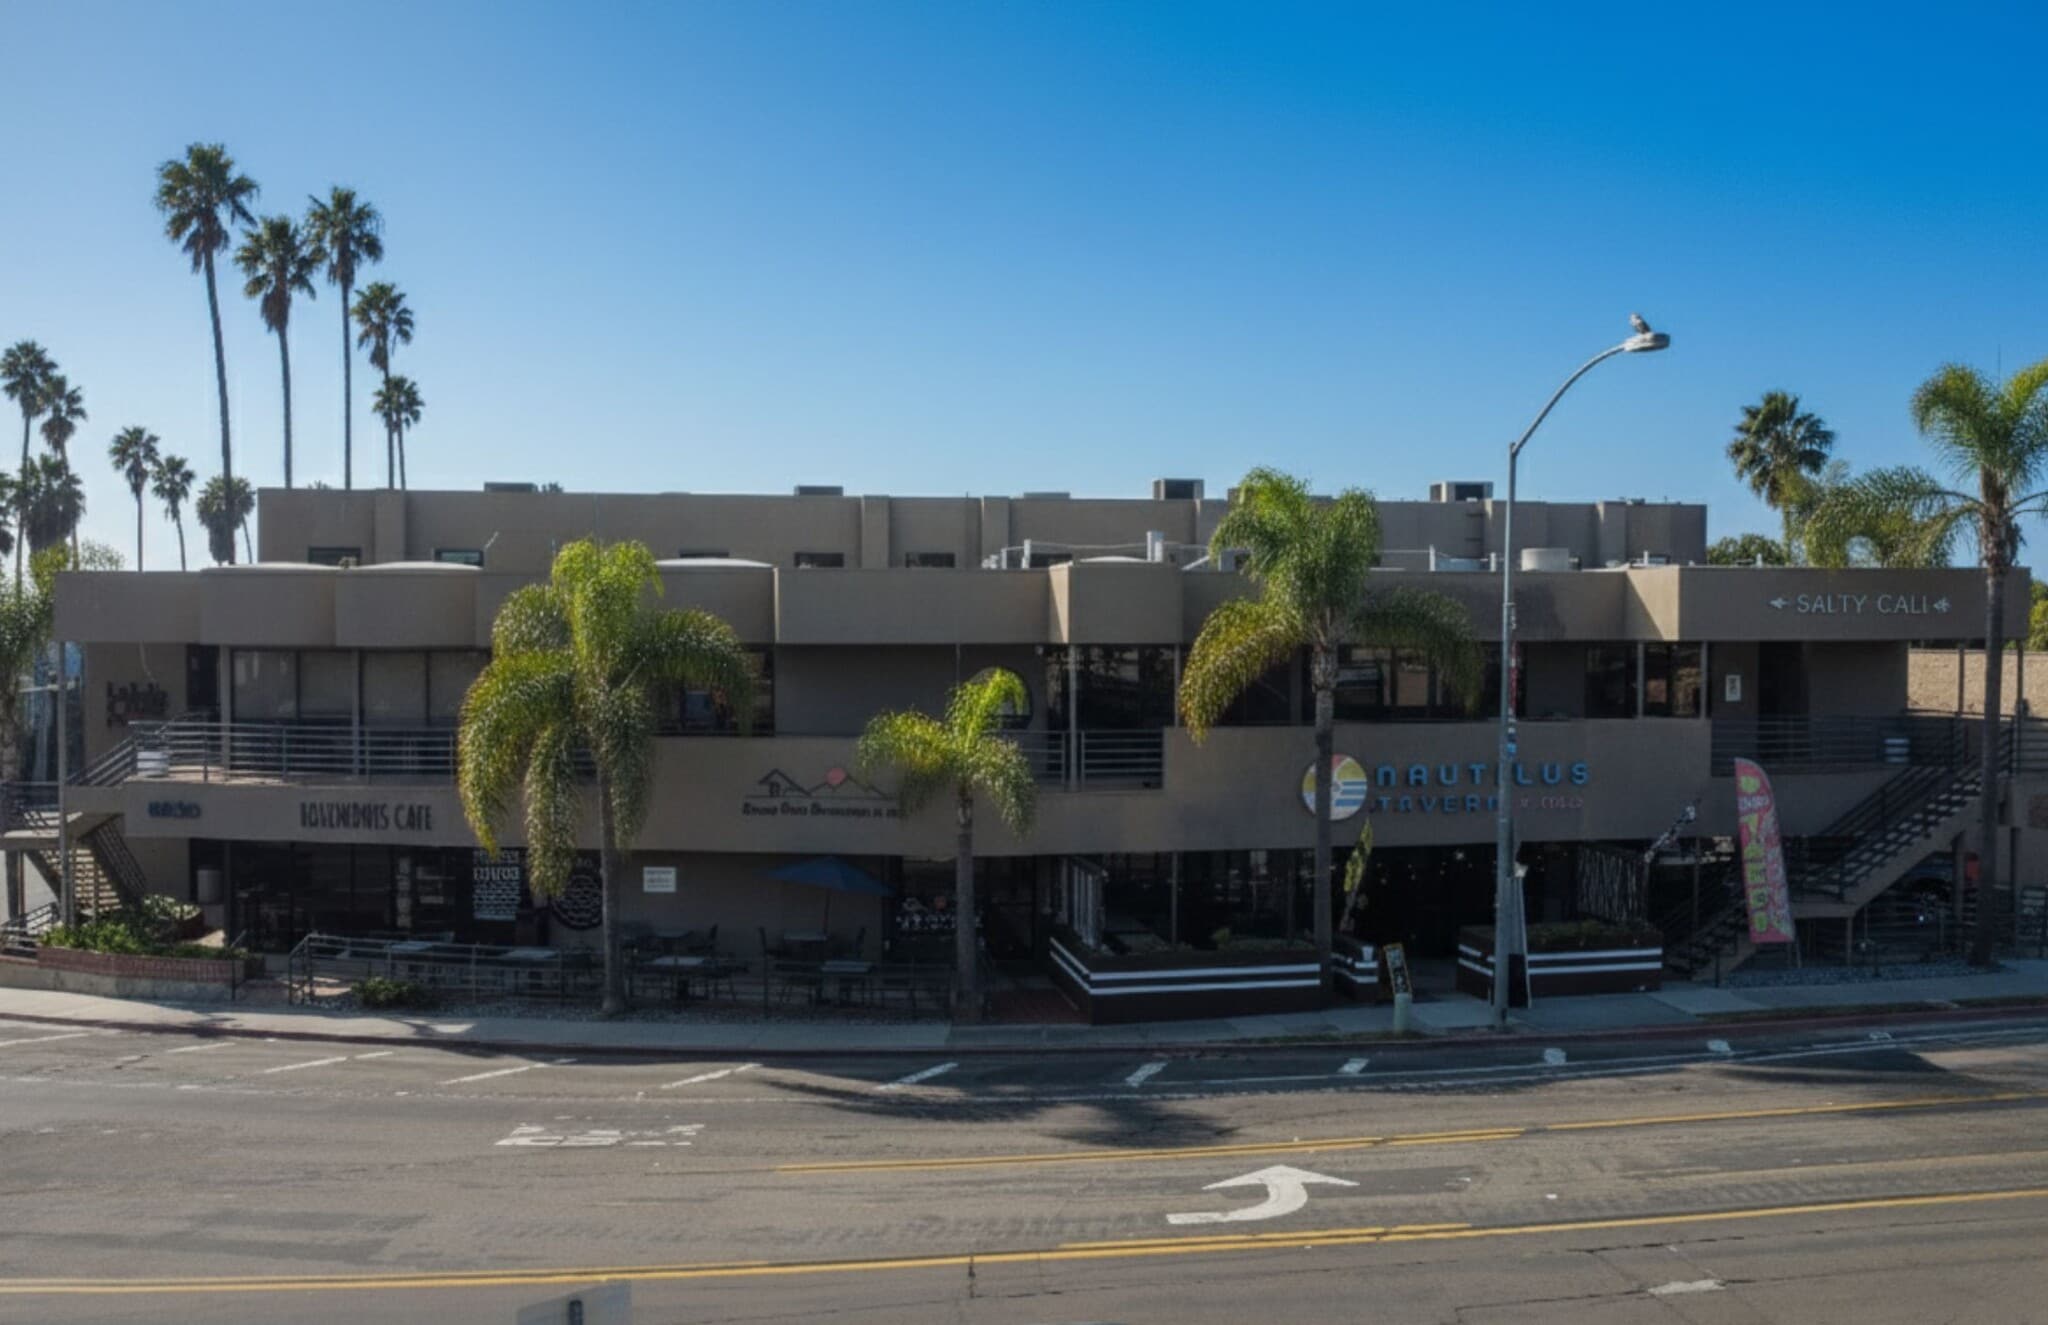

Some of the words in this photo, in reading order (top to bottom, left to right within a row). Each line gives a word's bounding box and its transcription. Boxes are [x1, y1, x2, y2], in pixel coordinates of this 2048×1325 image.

[1796, 593, 1867, 614] SALTY
[1877, 594, 1928, 614] CALI
[1375, 761, 1590, 787] NAUTLUS
[393, 803, 433, 831] CAFE
